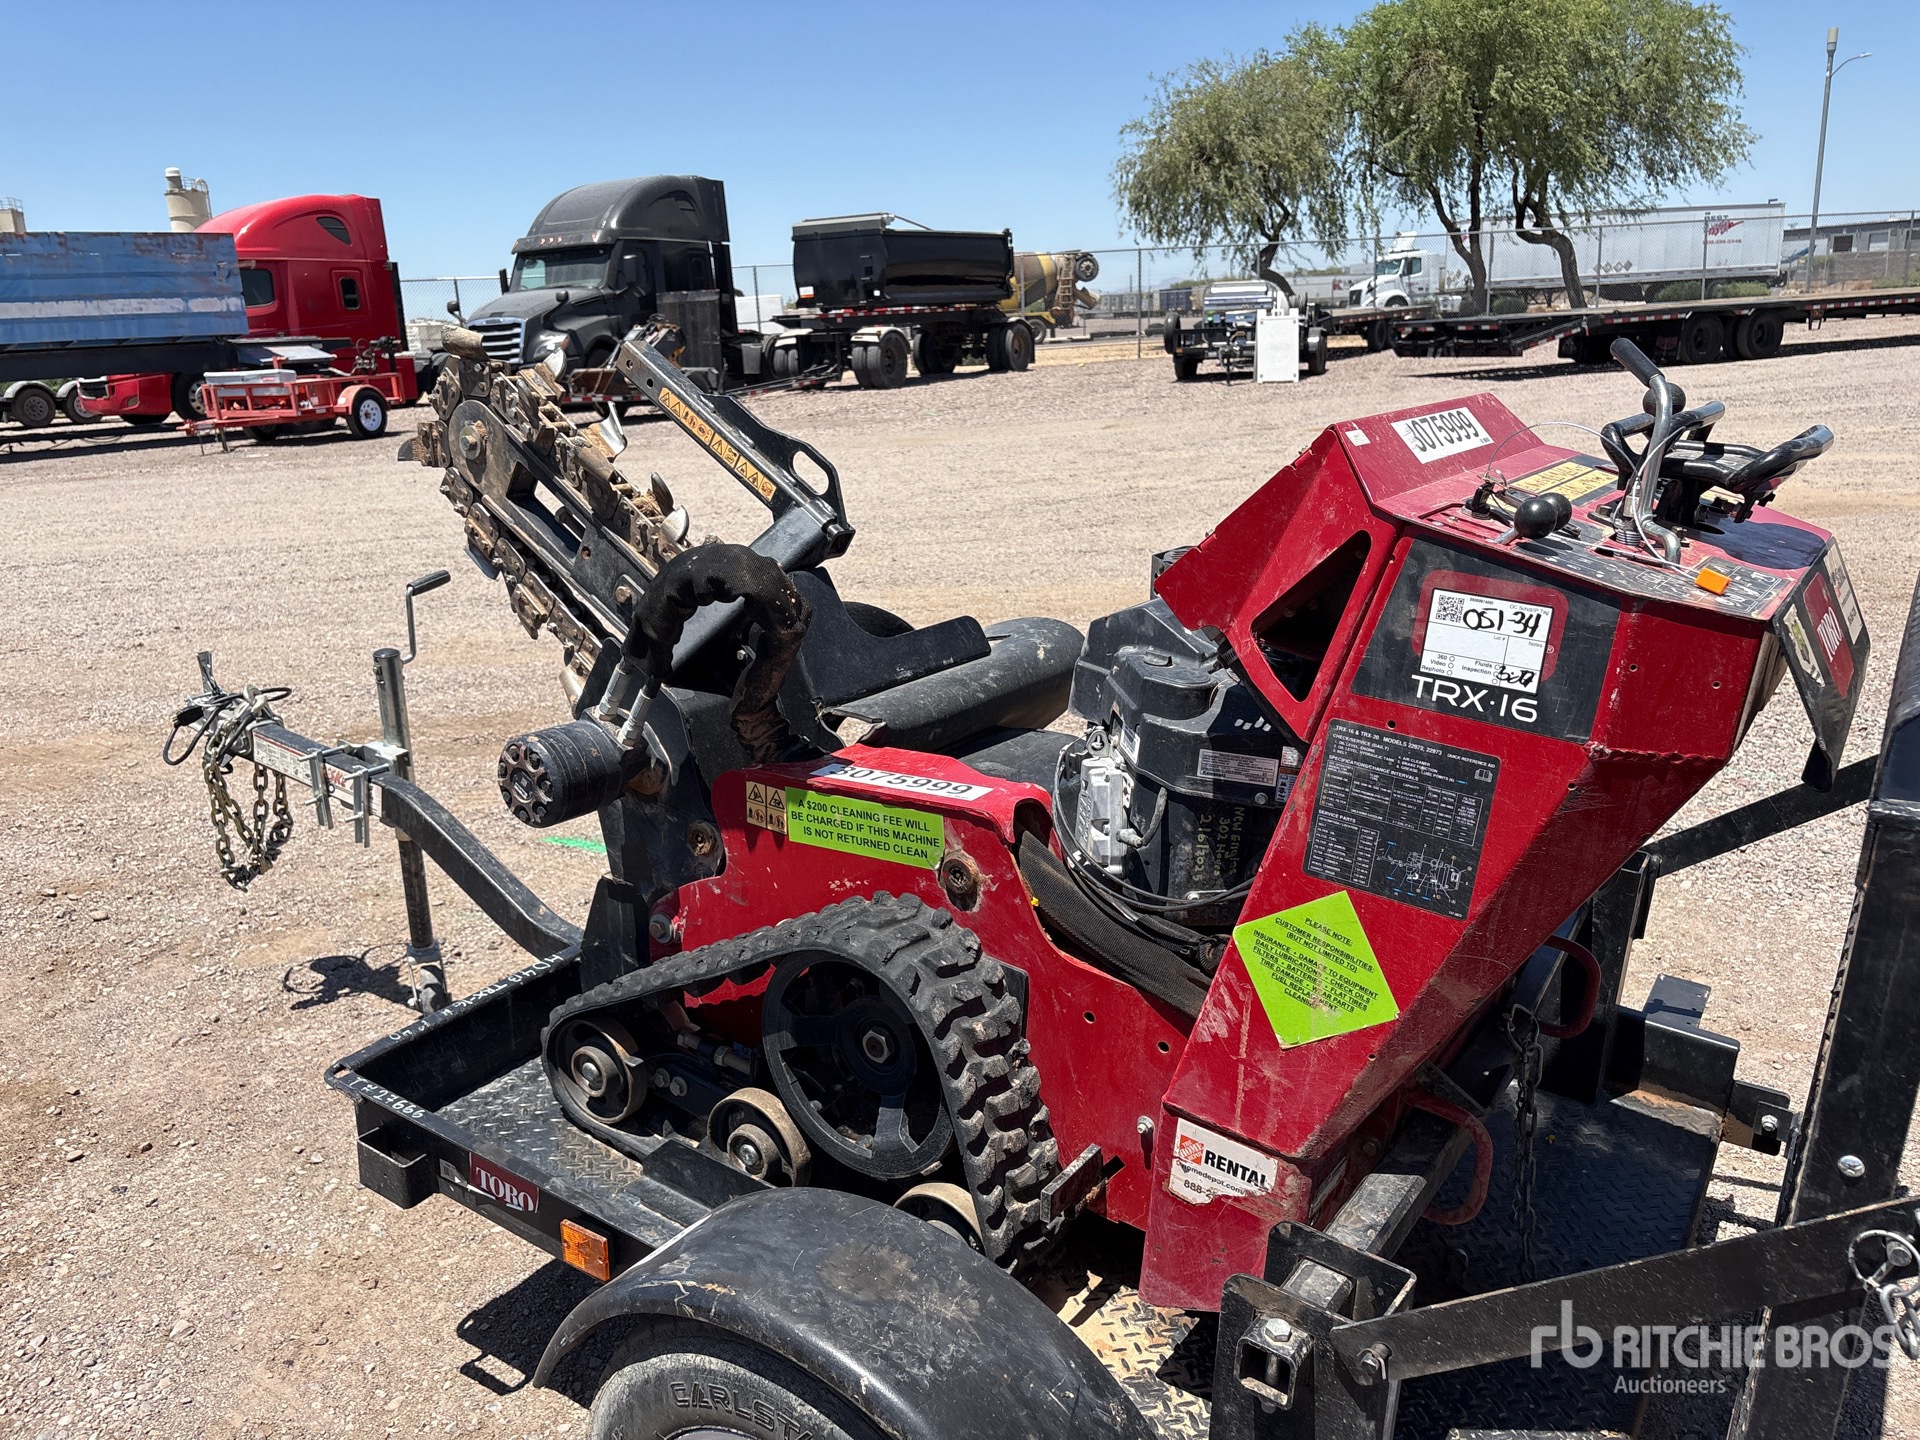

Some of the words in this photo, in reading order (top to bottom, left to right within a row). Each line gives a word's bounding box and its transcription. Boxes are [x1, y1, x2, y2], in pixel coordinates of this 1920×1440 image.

[1405, 410, 1479, 452] 3075999
[1816, 606, 1844, 663] TORO
[1430, 659, 1447, 667] Video
[1461, 665, 1492, 675] Inspection
[1475, 660, 1493, 669] Fluids
[830, 766, 973, 795] 3075999
[791, 811, 805, 821] BE
[806, 814, 854, 831] CHARGED
[856, 824, 865, 833] IF
[866, 825, 891, 838] THIS
[893, 831, 941, 848] MACHINE
[798, 799, 806, 808] A
[806, 801, 828, 813] $200
[830, 805, 881, 822] CLEANING
[883, 815, 903, 827] FEE
[904, 819, 931, 832] WILL
[1218, 817, 1230, 840] 302
[803, 826, 813, 836] IS
[814, 828, 834, 840] NOT
[836, 833, 891, 851] RETURNED
[893, 844, 928, 859] CLEAN
[1275, 917, 1312, 940] CUSTOMER
[1305, 918, 1332, 935] PLEASE
[1253, 929, 1291, 953] INSURANCE
[1328, 969, 1338, 978] TO
[1339, 975, 1379, 999] EQUIPMENT
[1287, 931, 1303, 944] (BUT
[1303, 940, 1318, 951] NOT
[1318, 947, 1345, 965] LIMITED
[1345, 962, 1358, 973] TO)
[1253, 945, 1280, 963] FILTERS
[1330, 987, 1348, 1000] FLAT
[1348, 997, 1368, 1011] TIRES
[1256, 938, 1275, 952] DAILY
[1330, 978, 1354, 994] CHECK
[1354, 991, 1371, 1004] OILS
[1260, 958, 1276, 969] TIRE
[1275, 966, 1304, 985] DAMAGE
[1333, 996, 1356, 1012] PARTS
[1271, 972, 1289, 985] FUEL
[1289, 982, 1338, 1011] REPLAMENT
[1284, 988, 1318, 1010] CLEANIN
[475, 1166, 535, 1212] TORO
